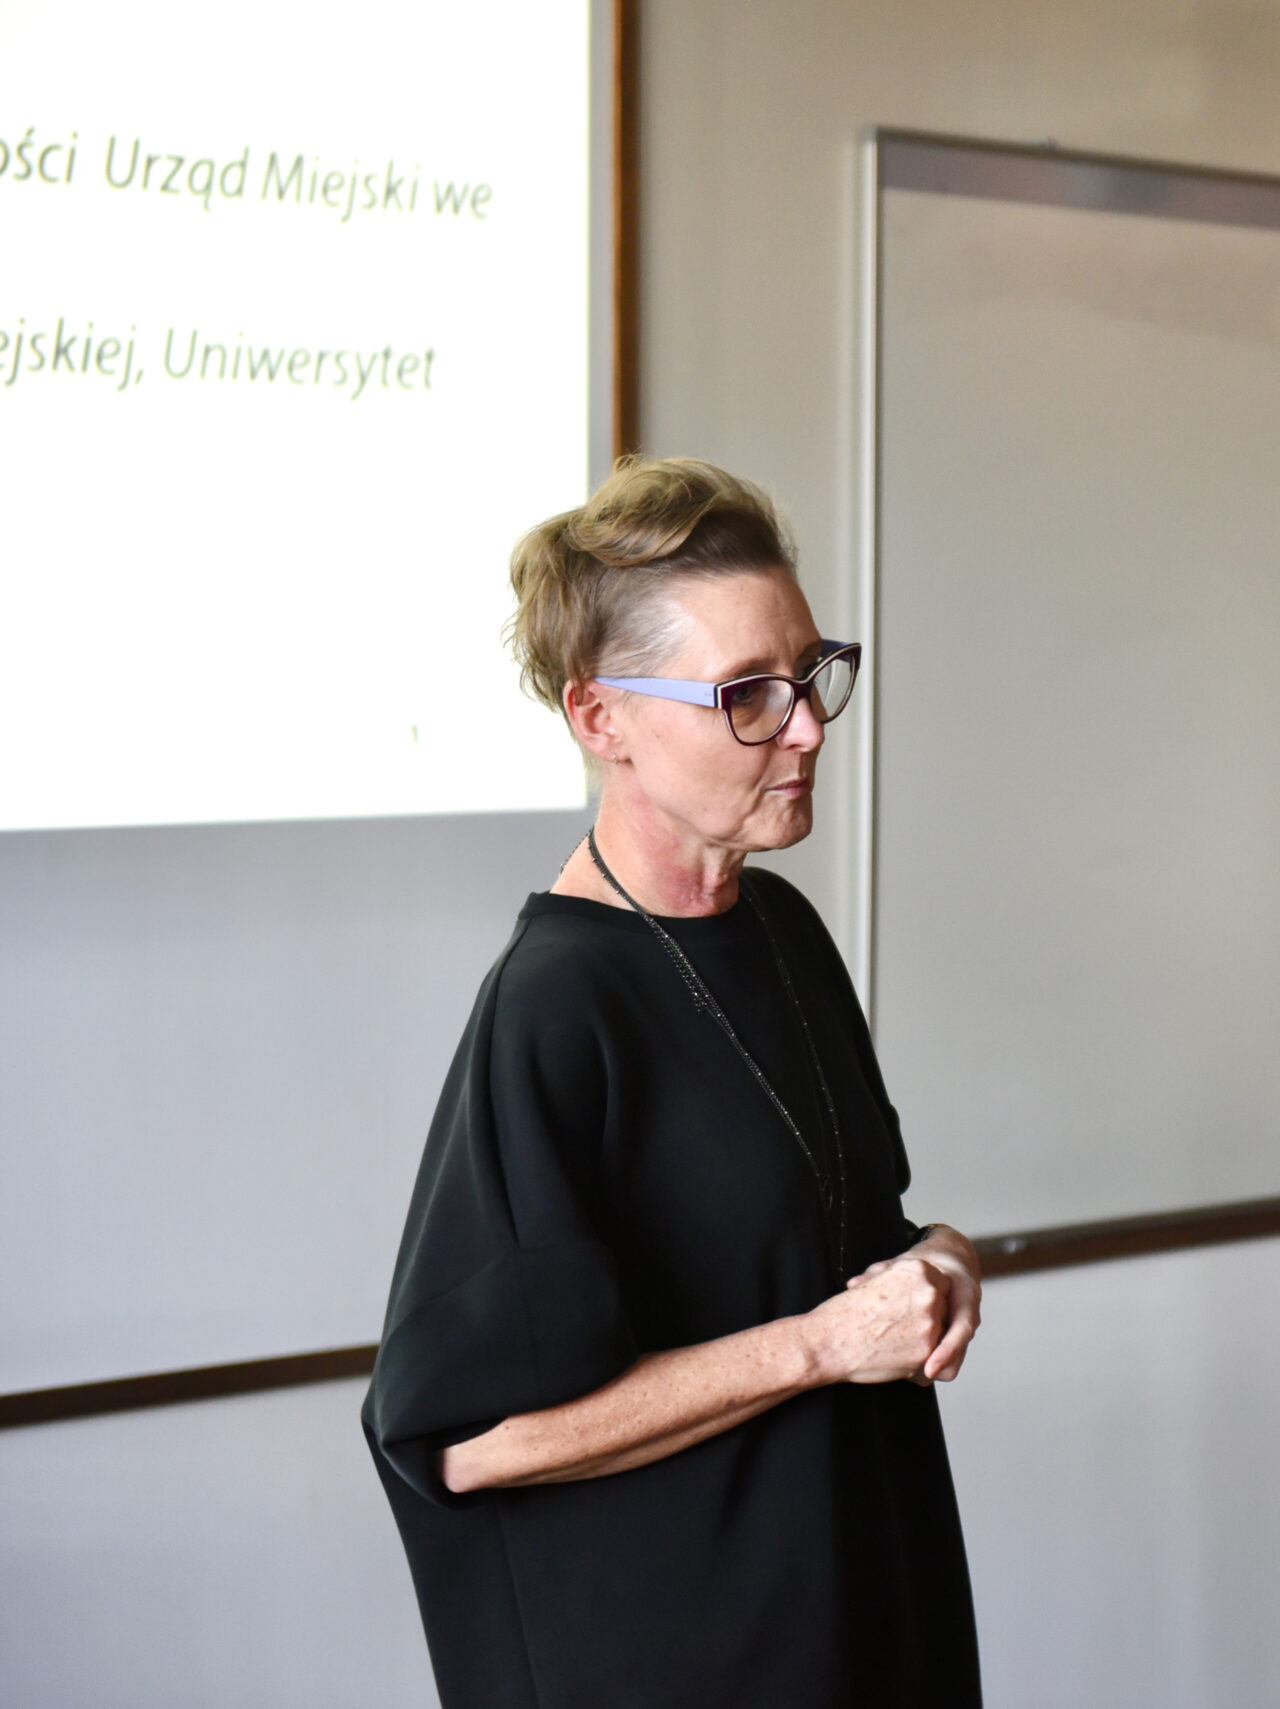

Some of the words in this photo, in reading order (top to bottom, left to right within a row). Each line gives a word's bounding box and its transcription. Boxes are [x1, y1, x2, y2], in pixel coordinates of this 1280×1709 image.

[105, 136, 249, 212] Urząd
[262, 150, 420, 223] Miejski
[433, 179, 493, 220] we
[164, 328, 437, 401] Uniwersytet
